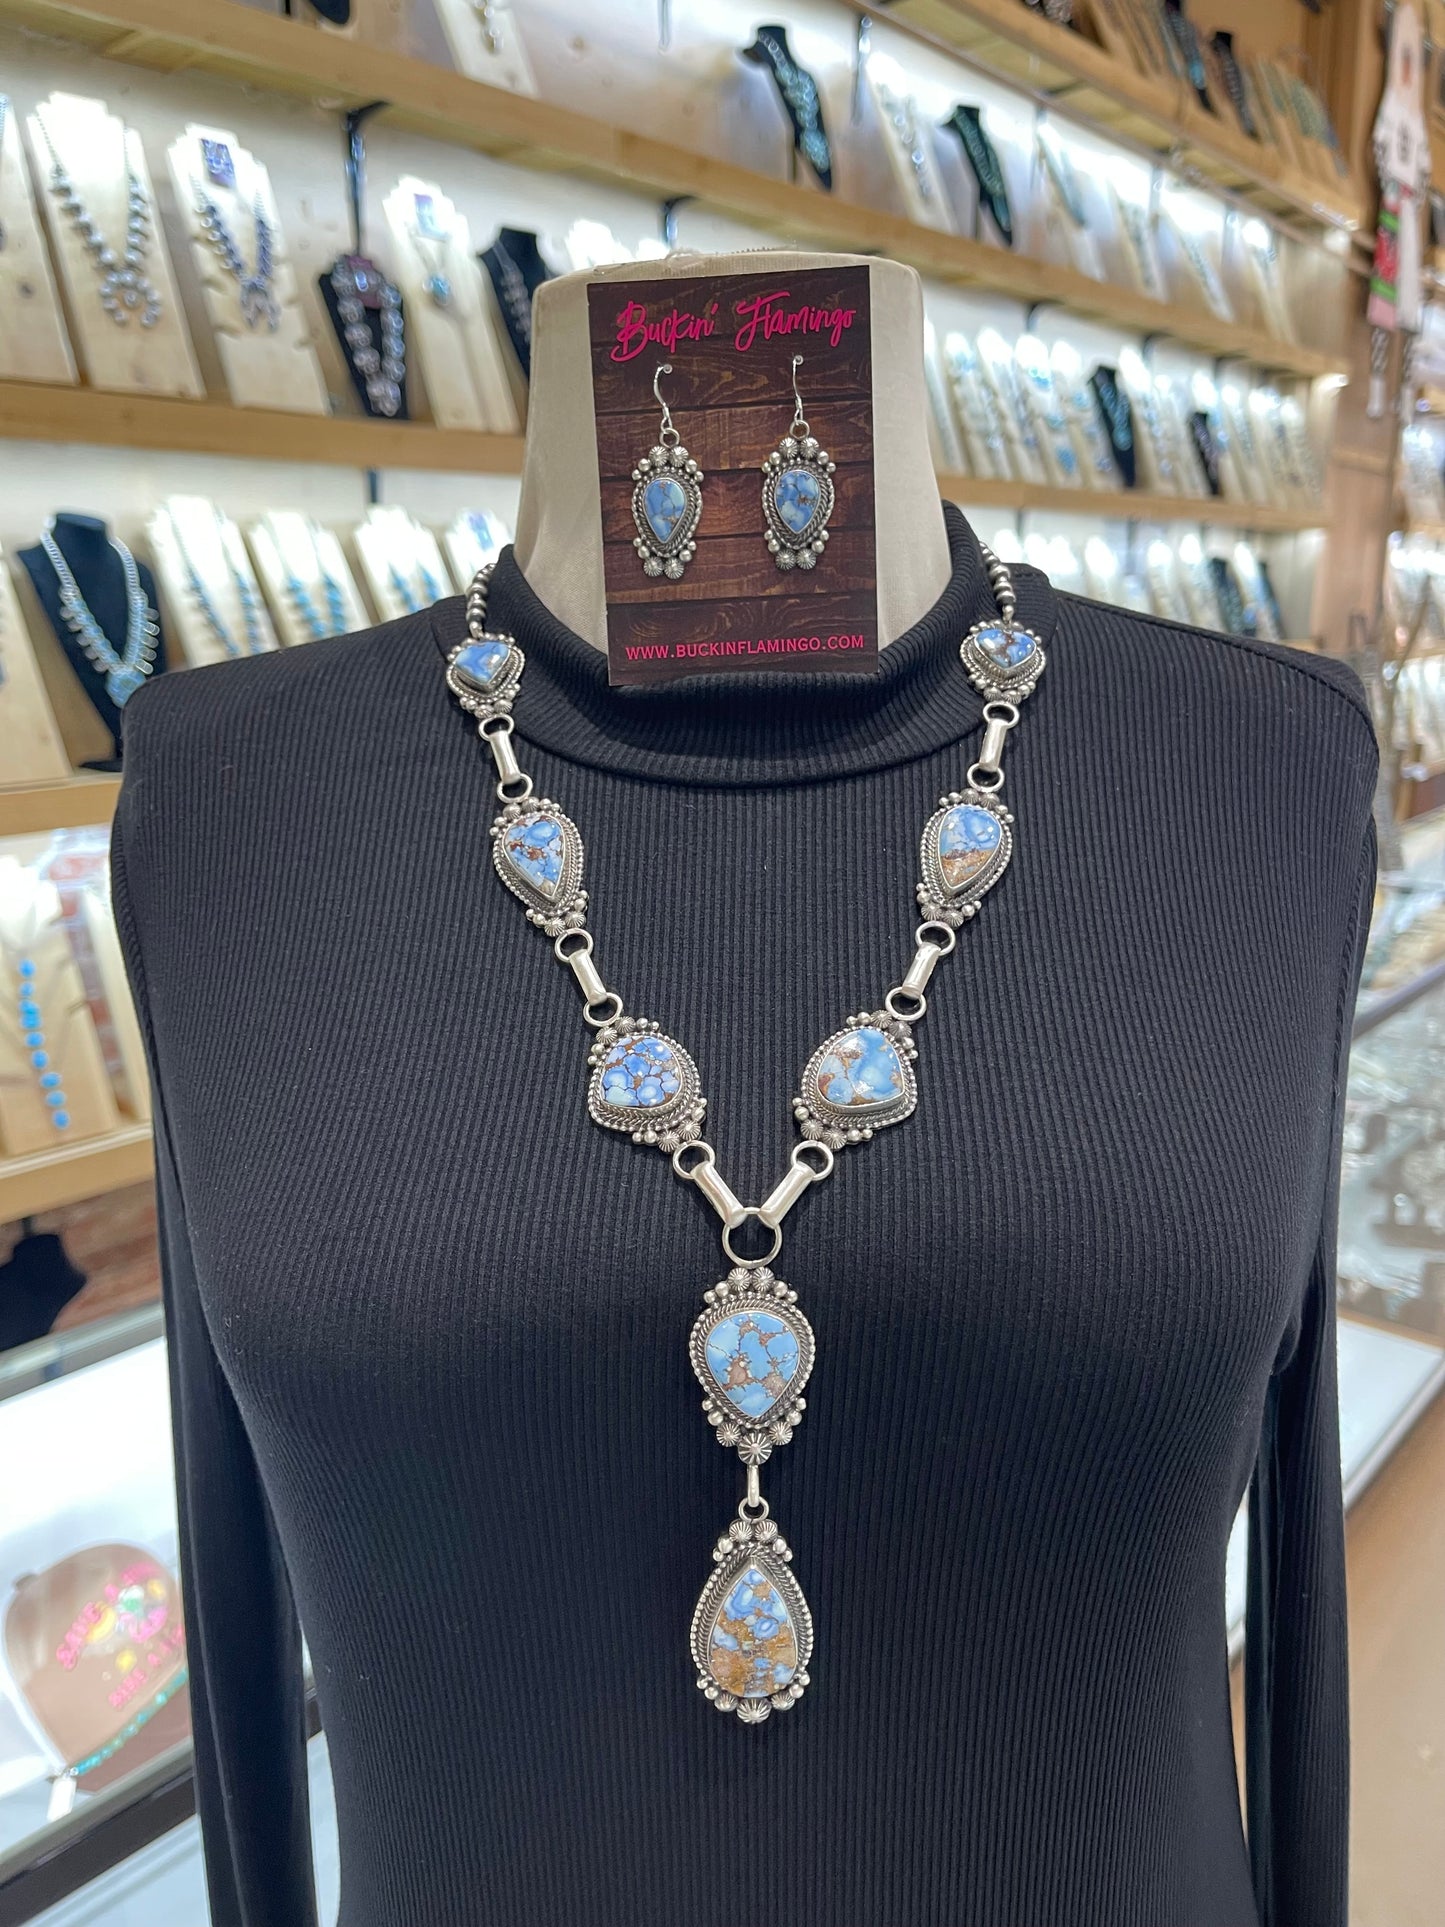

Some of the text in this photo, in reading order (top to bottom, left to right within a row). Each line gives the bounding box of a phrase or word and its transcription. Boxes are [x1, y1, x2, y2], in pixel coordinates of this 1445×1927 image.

[611, 292, 856, 361] Buckin' Flamingo
[626, 635, 864, 660] WWW.BUCKINFLAMINGO.COM
